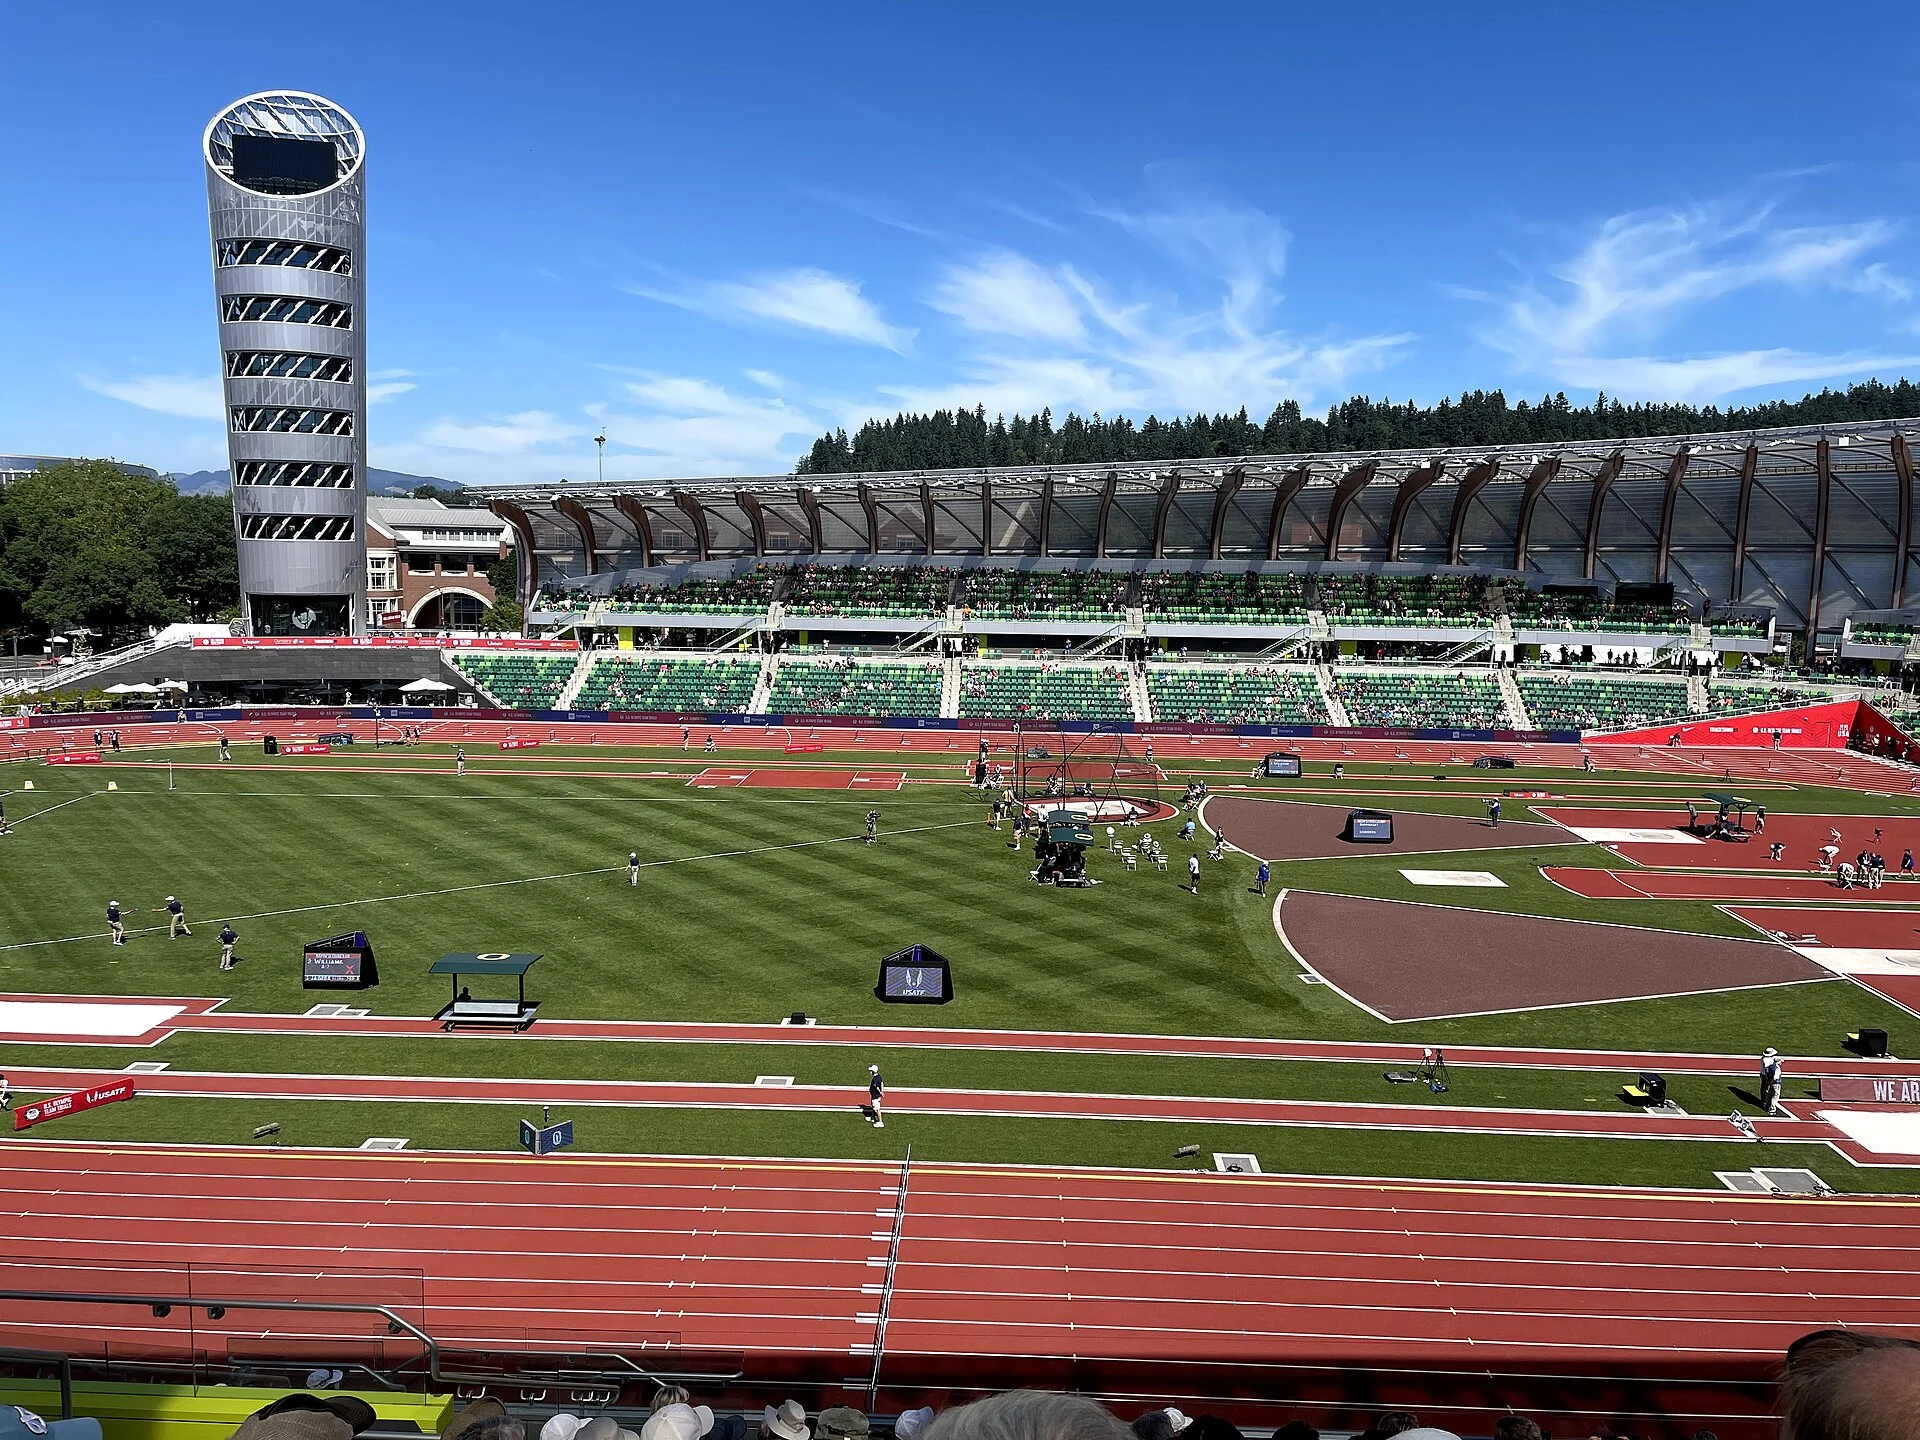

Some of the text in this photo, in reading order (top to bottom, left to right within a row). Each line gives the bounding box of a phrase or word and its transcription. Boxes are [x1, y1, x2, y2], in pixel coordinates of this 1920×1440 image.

[98, 1087, 126, 1099] USATF
[1873, 1081, 1896, 1101] WE
[52, 1097, 72, 1106] OLYMPIC
[44, 1106, 56, 1114] TEAM
[57, 1102, 72, 1112] TRIALS
